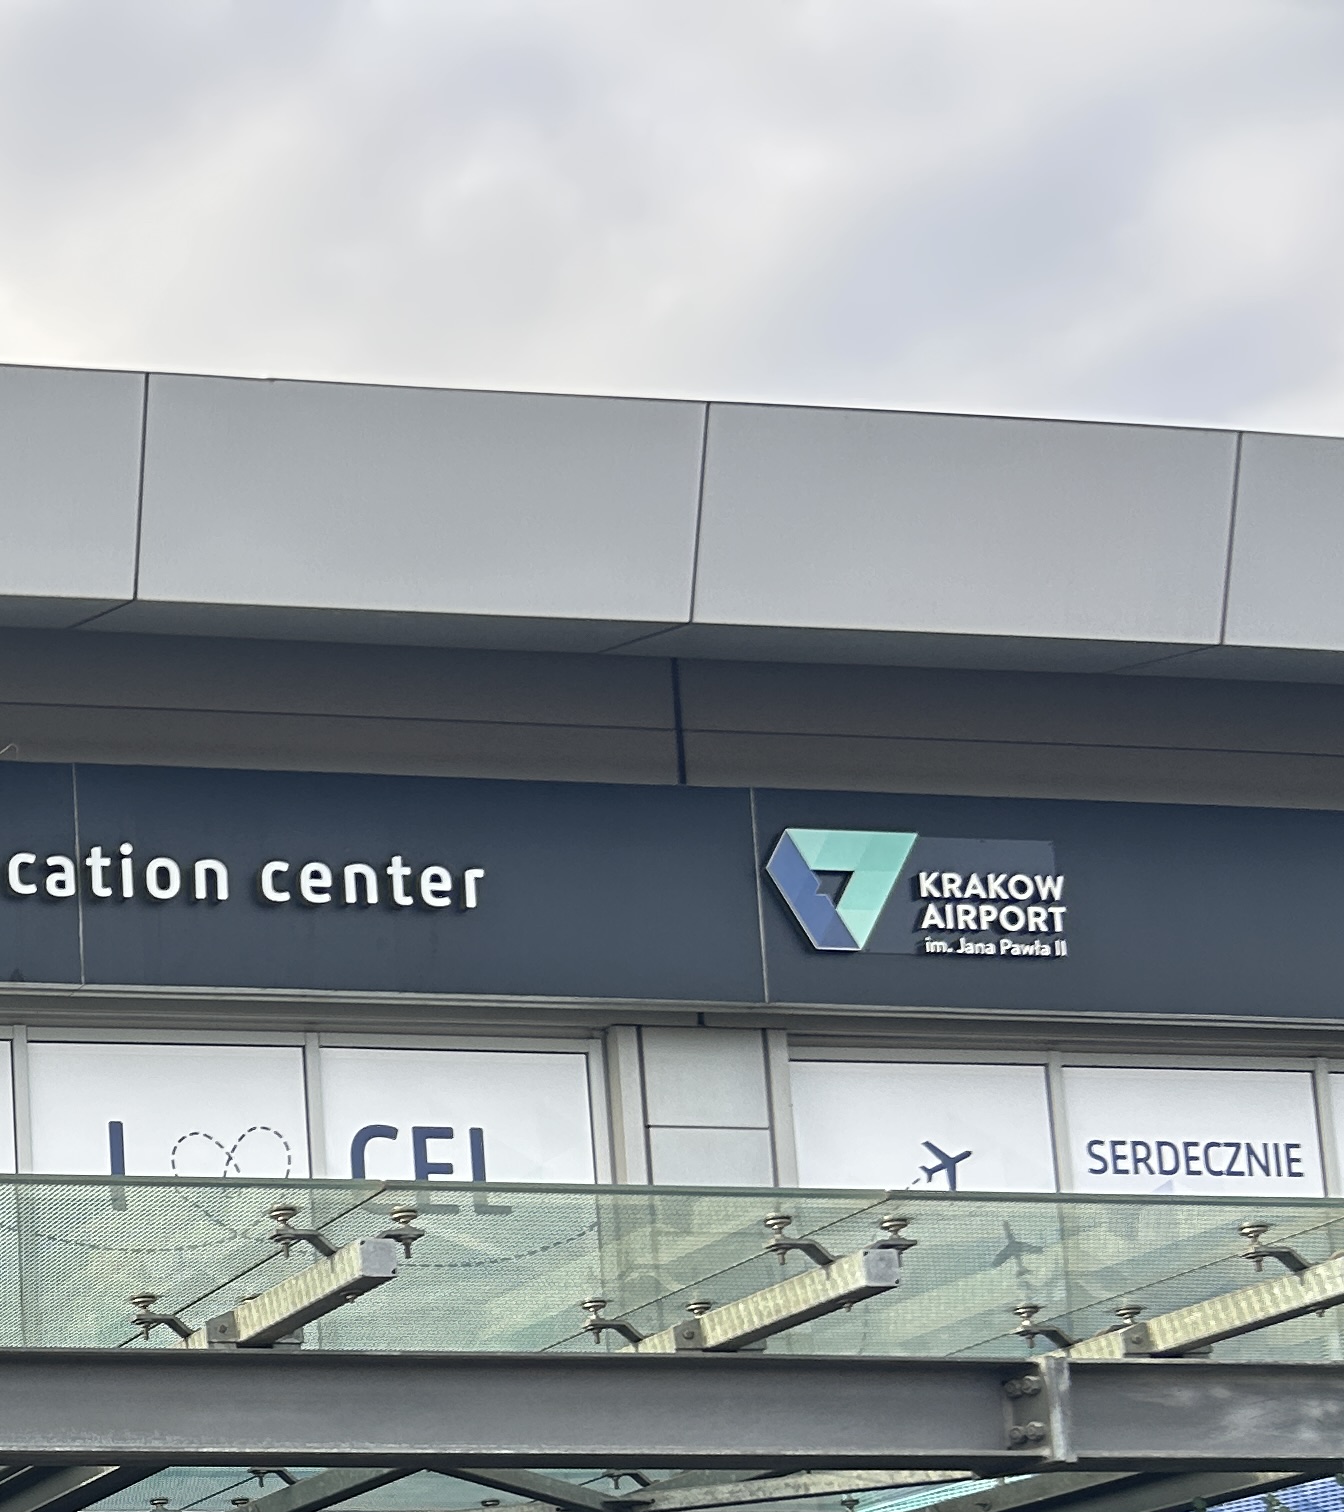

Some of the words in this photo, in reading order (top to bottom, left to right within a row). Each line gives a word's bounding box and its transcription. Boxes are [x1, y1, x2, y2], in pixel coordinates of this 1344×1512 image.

[261, 855, 485, 909] center
[918, 871, 1064, 901] KRAKOW
[921, 904, 1067, 933] AIRPORT
[925, 937, 954, 954] im.
[957, 938, 996, 955] Jana
[1000, 939, 1051, 957] Pawła
[1055, 940, 1068, 957] II
[350, 1124, 512, 1216] CEL
[1087, 1140, 1305, 1178] SERDECZNIE
